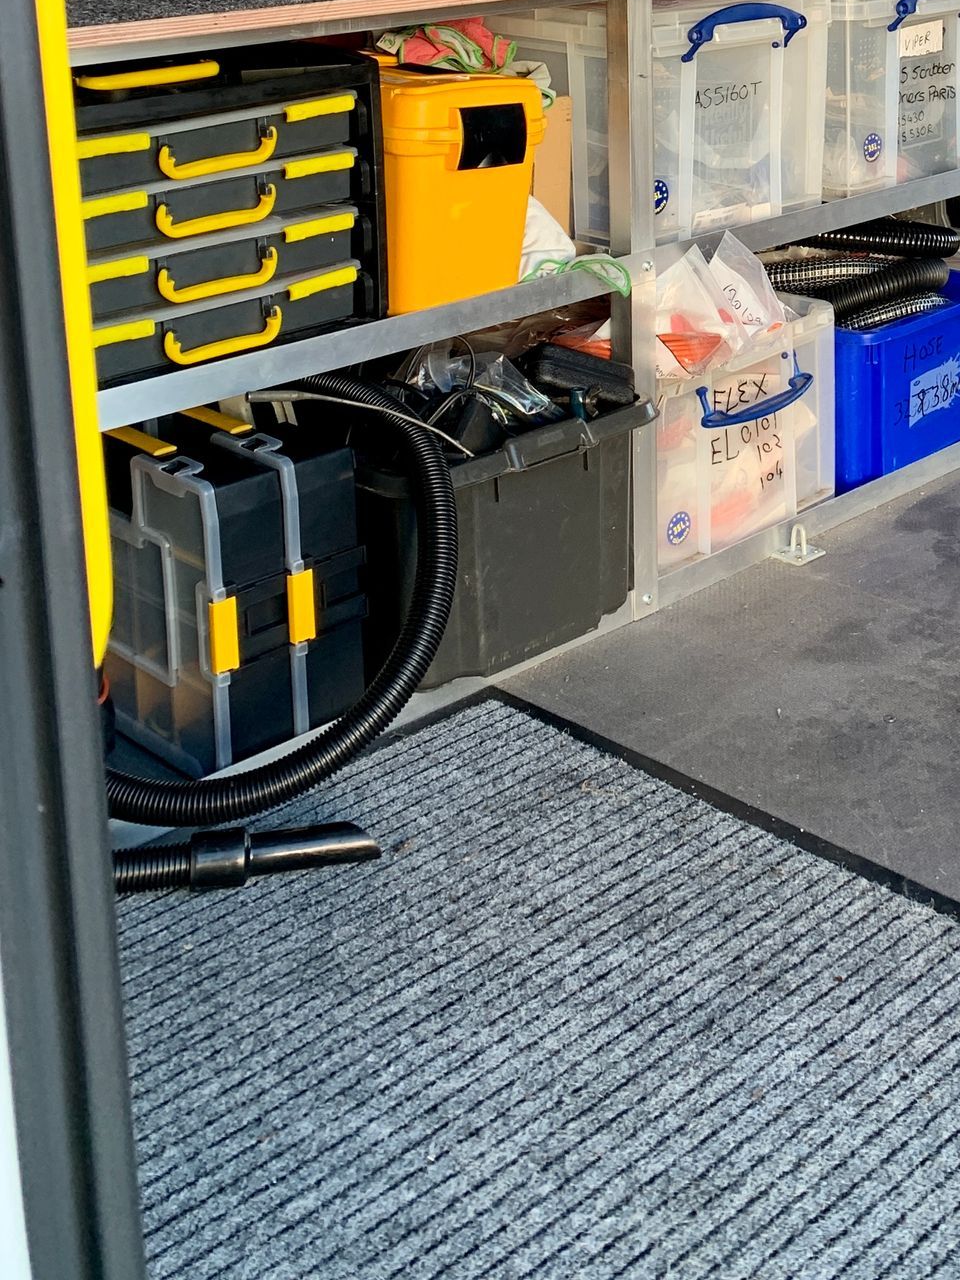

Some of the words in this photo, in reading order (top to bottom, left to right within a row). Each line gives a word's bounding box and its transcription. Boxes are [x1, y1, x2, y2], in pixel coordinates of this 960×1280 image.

[904, 30, 931, 51] VIPER
[695, 80, 762, 109] AS5160T
[928, 84, 957, 102] PARTS
[904, 335, 944, 373] HOSE
[713, 373, 767, 414] FLEX
[760, 460, 783, 490] 104
